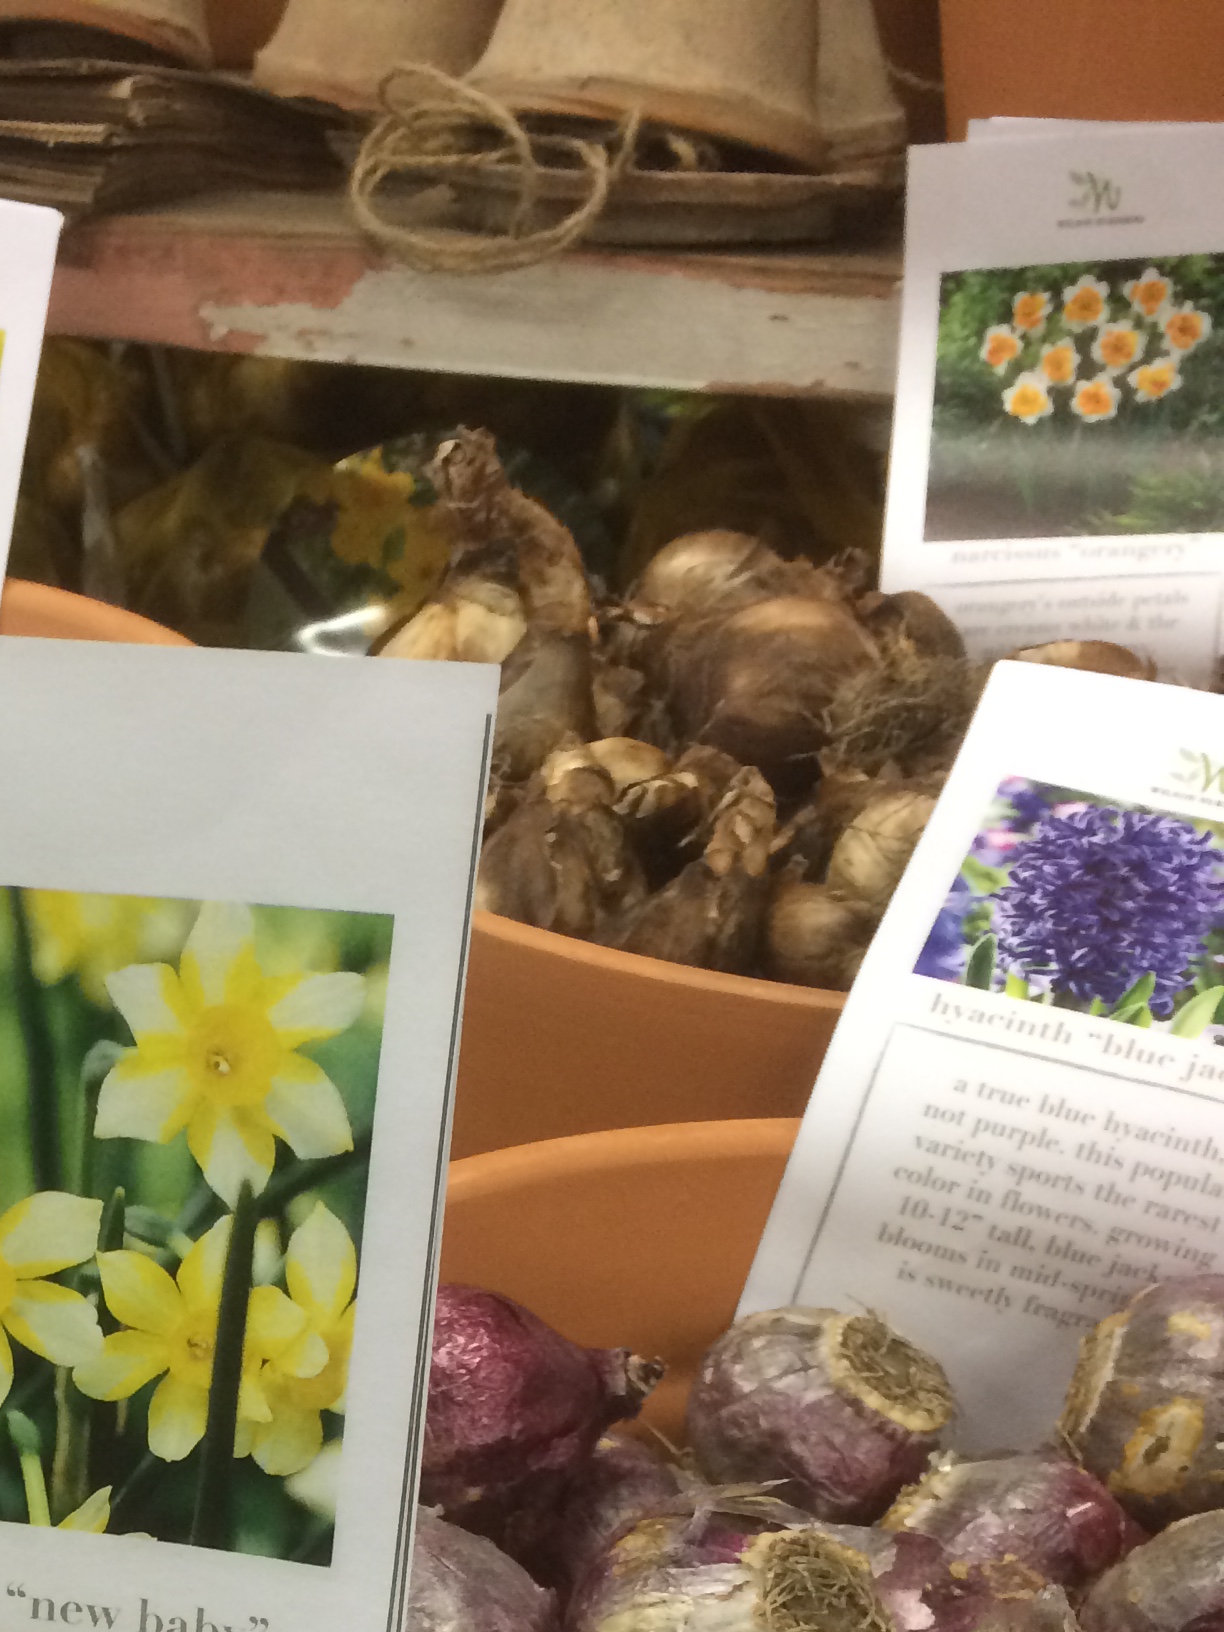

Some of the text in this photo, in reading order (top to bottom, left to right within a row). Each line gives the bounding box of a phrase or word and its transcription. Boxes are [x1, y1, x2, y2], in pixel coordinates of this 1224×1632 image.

[930, 992, 1072, 1045] hyacinth
[1088, 1030, 1176, 1068] “blue
[953, 1079, 968, 1093] a
[976, 1080, 1030, 1108] true
[1038, 1094, 1096, 1126] blue
[923, 1104, 967, 1126] not
[1076, 1141, 1125, 1169] this
[915, 1135, 1222, 1233] variety sports the rarest
[894, 1167, 960, 1194] color
[967, 1180, 992, 1205] in
[1105, 1226, 1218, 1271] growing
[878, 1222, 968, 1264] blooms
[977, 1250, 1001, 1273] in
[1045, 1235, 1101, 1266] blue
[898, 1261, 917, 1282] is
[927, 1274, 1012, 1314] sweetly
[6, 1583, 120, 1631] “new
